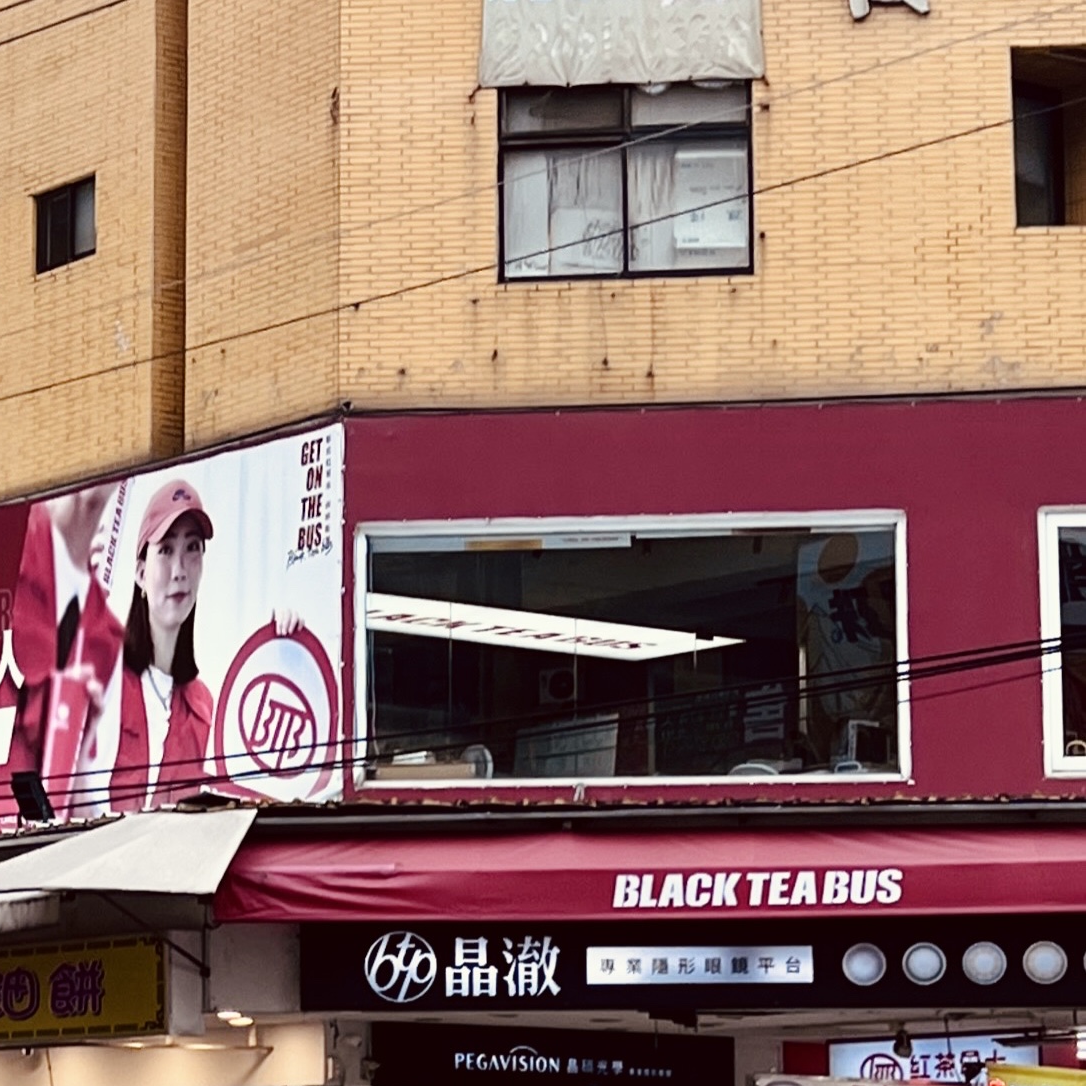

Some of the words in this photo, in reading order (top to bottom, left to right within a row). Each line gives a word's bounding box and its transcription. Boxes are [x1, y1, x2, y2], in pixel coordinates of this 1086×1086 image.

[300, 437, 324, 467] GET
[305, 464, 324, 492] ON
[300, 493, 323, 522] THE
[297, 522, 323, 552] BUS
[102, 534, 118, 585] BLACK
[612, 871, 743, 908] BLACK
[745, 870, 818, 907] TEA
[821, 868, 904, 905] BUS
[598, 954, 803, 977] 專業隱形眼鏡平台
[453, 1050, 562, 1074] PEGAVISION
